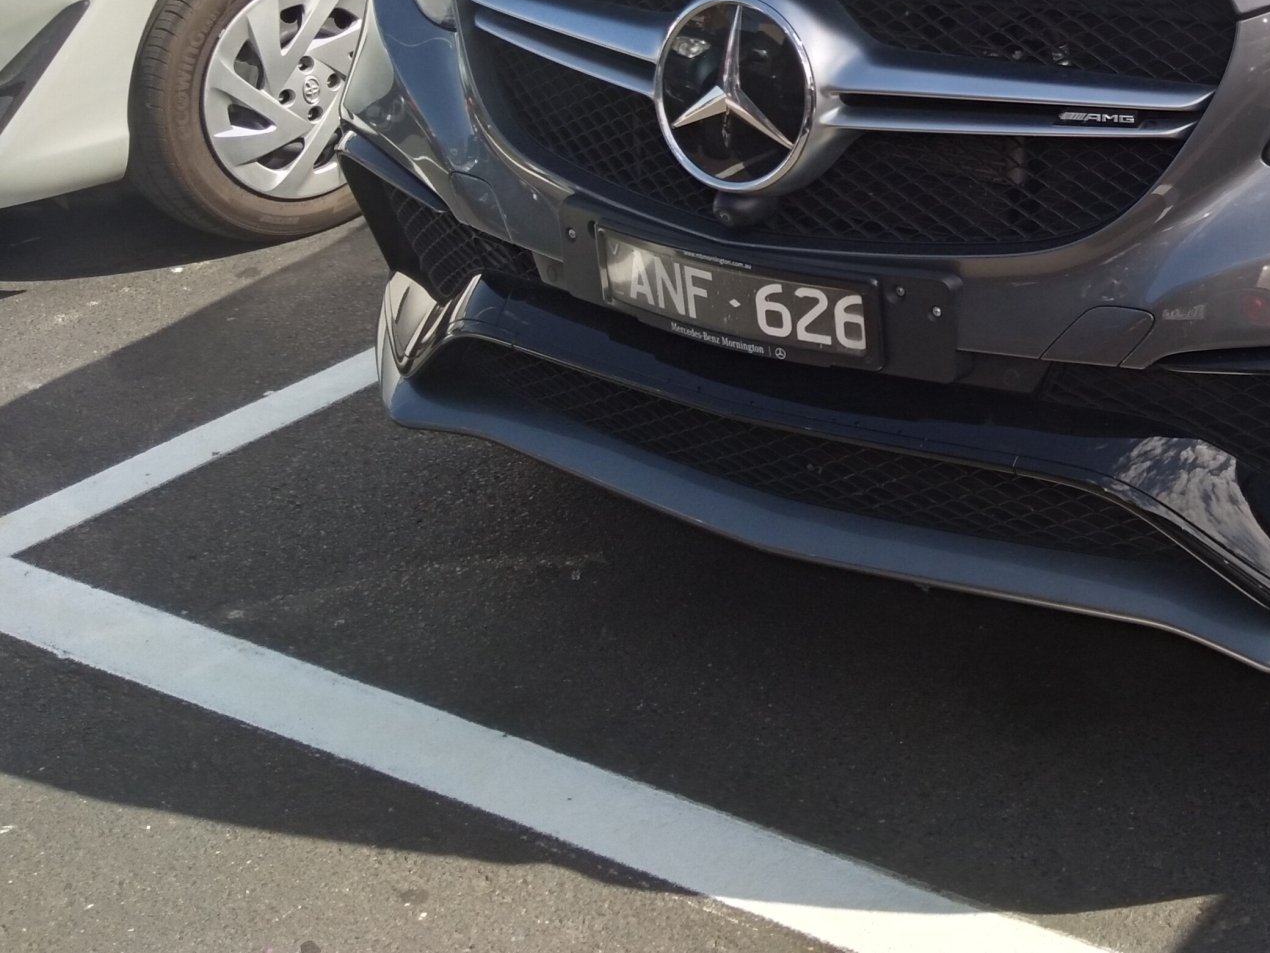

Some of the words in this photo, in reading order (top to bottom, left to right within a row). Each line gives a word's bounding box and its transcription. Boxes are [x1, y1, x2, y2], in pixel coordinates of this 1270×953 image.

[1085, 113, 1135, 124] AMG
[630, 249, 713, 319] ANF
[755, 284, 867, 349] 626
[670, 321, 720, 344] Mercedes-Benz
[721, 336, 765, 354] Mornington
